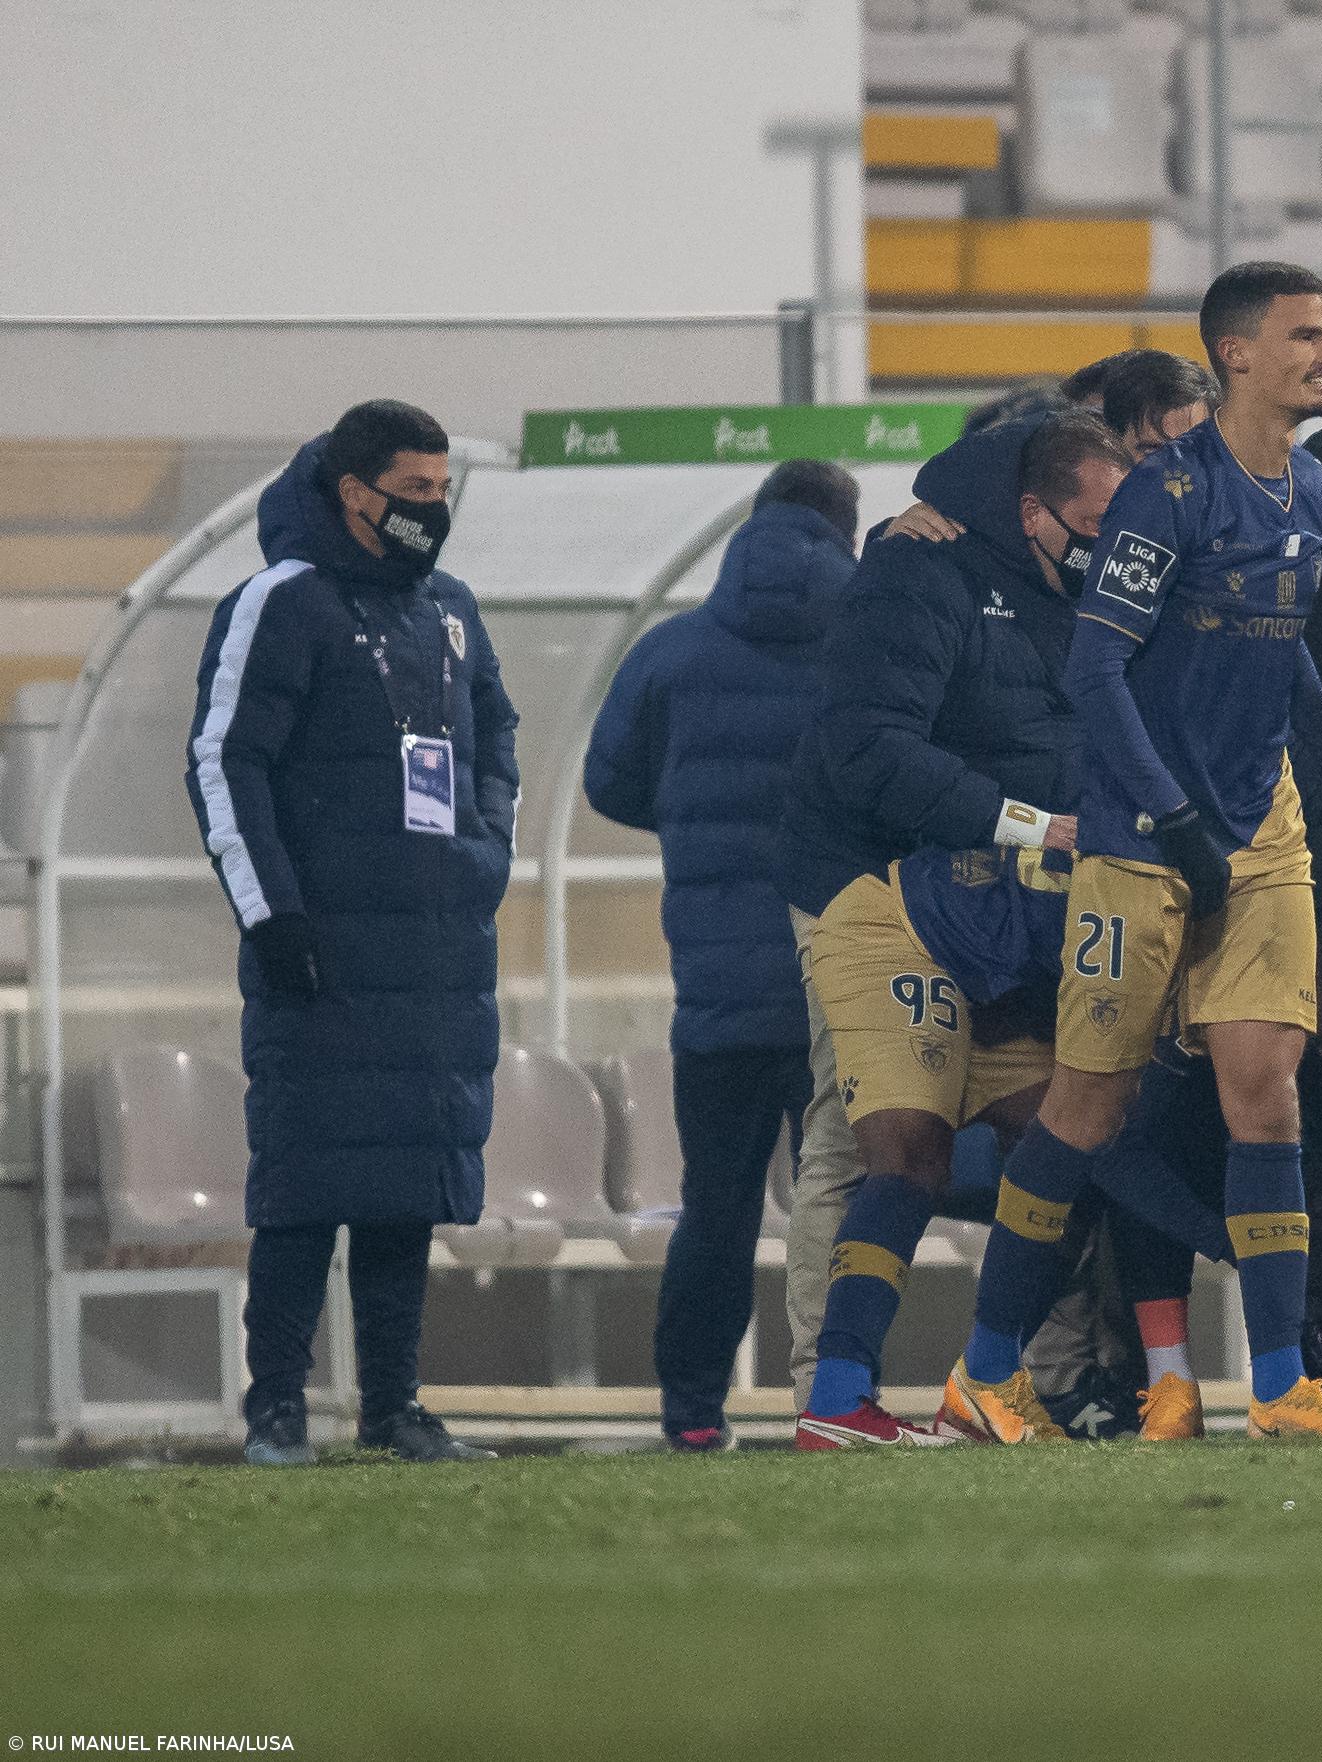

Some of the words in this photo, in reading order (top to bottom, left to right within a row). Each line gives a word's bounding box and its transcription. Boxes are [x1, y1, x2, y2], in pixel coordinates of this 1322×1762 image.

[1128, 542, 1157, 564] LIGA
[1106, 560, 1159, 594] NOS
[983, 606, 1016, 618] KELME
[1075, 911, 1126, 981] 21
[891, 972, 960, 1031] 95
[1247, 1223, 1309, 1242] CDS
